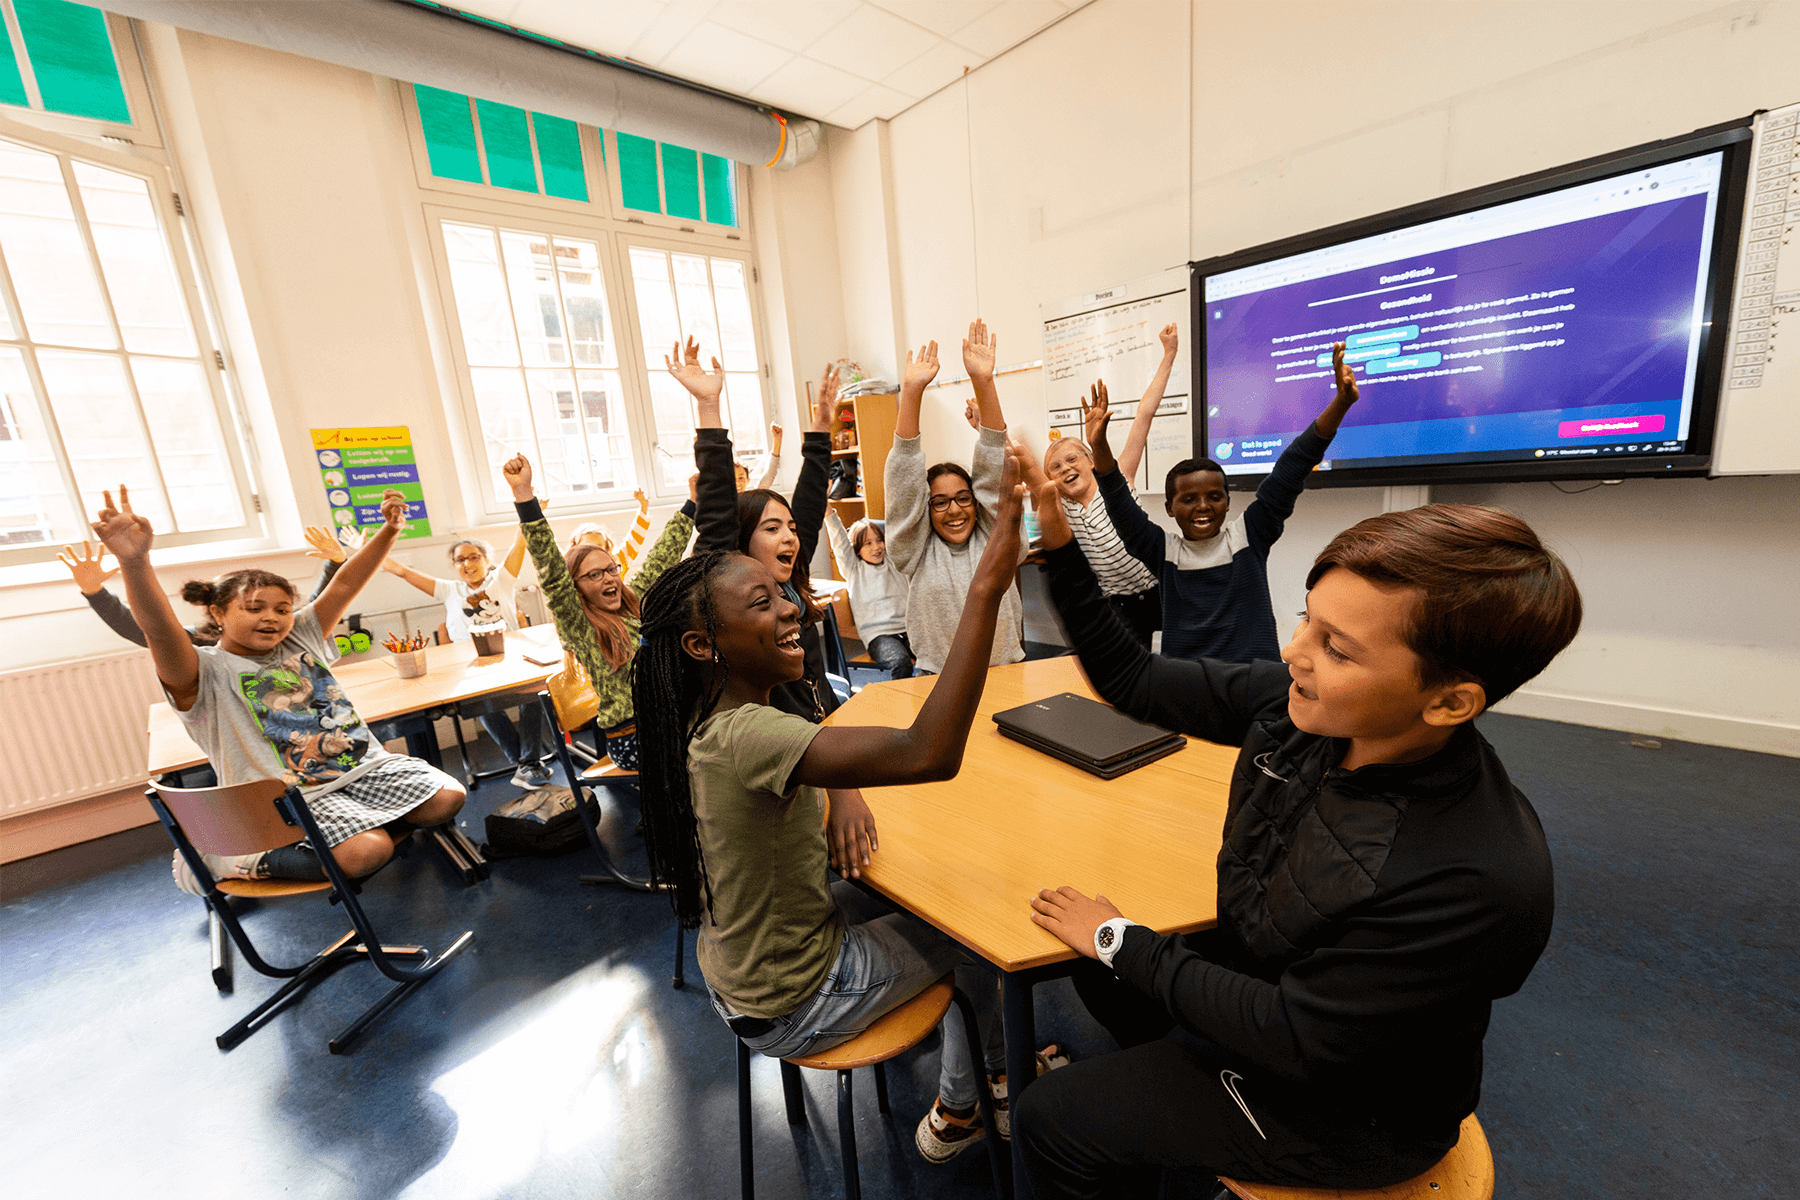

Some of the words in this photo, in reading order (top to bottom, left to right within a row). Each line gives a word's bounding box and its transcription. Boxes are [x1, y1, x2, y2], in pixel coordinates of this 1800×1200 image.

[1765, 115, 1794, 128] 08:30
[1763, 130, 1792, 142] 08:45
[1761, 142, 1790, 154] 09:00
[1760, 154, 1788, 166] 09:15
[1758, 166, 1788, 178] 09:30
[1757, 178, 1786, 190] 09:45
[1756, 192, 1784, 202] 10:00
[1755, 204, 1782, 214] 10:15
[1754, 216, 1782, 227] 10:30
[1752, 228, 1780, 240] 10:45
[1750, 241, 1776, 251] 11:00
[1748, 262, 1774, 272] 11:30
[1746, 274, 1773, 284] 11:45
[1746, 284, 1772, 294] 12:00
[1380, 293, 1432, 310] Gezondheid
[1742, 307, 1768, 318] 12:30
[1740, 332, 1766, 342] 13:00
[1736, 355, 1763, 365] 13:30
[1241, 441, 1255, 450] Dat
